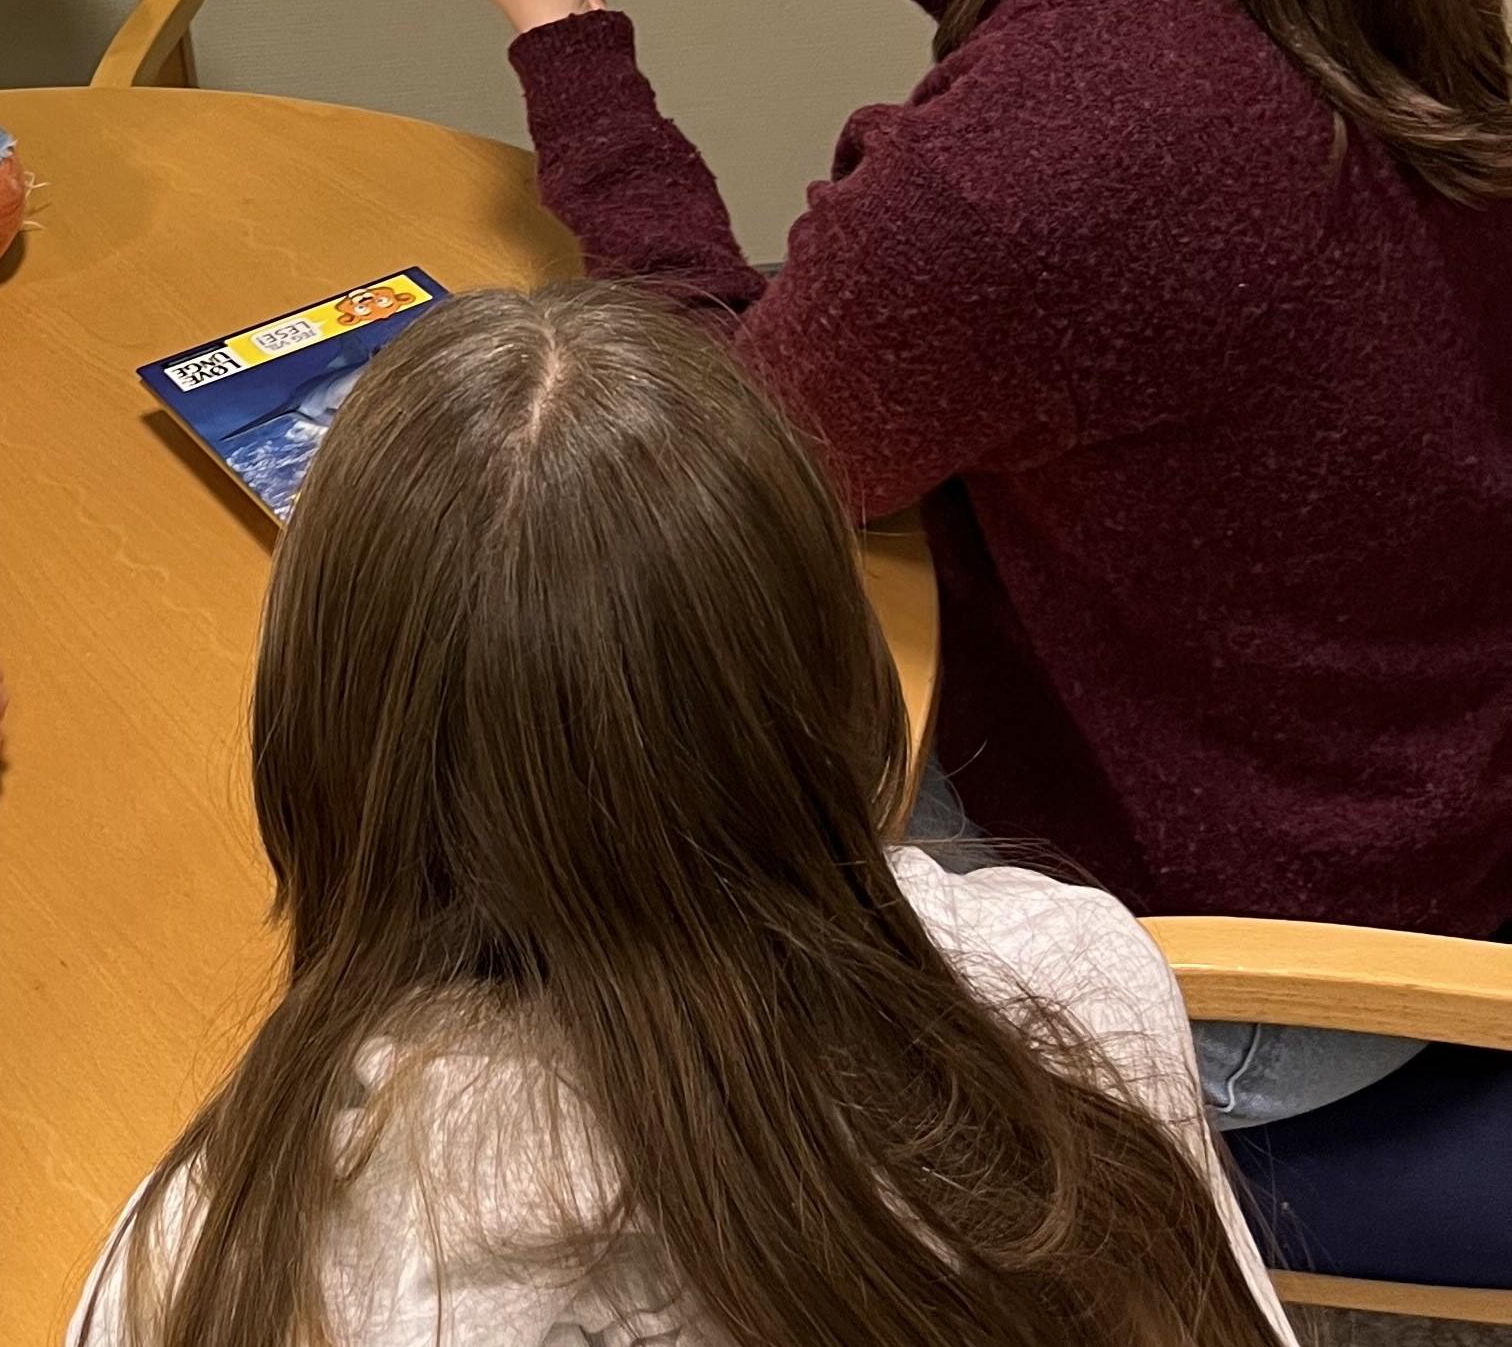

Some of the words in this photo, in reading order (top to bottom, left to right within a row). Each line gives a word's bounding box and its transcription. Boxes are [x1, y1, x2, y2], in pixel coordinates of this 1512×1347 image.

[257, 321, 311, 346] LESE!
[172, 351, 230, 378] UNGE
[181, 358, 242, 386] LØVE
